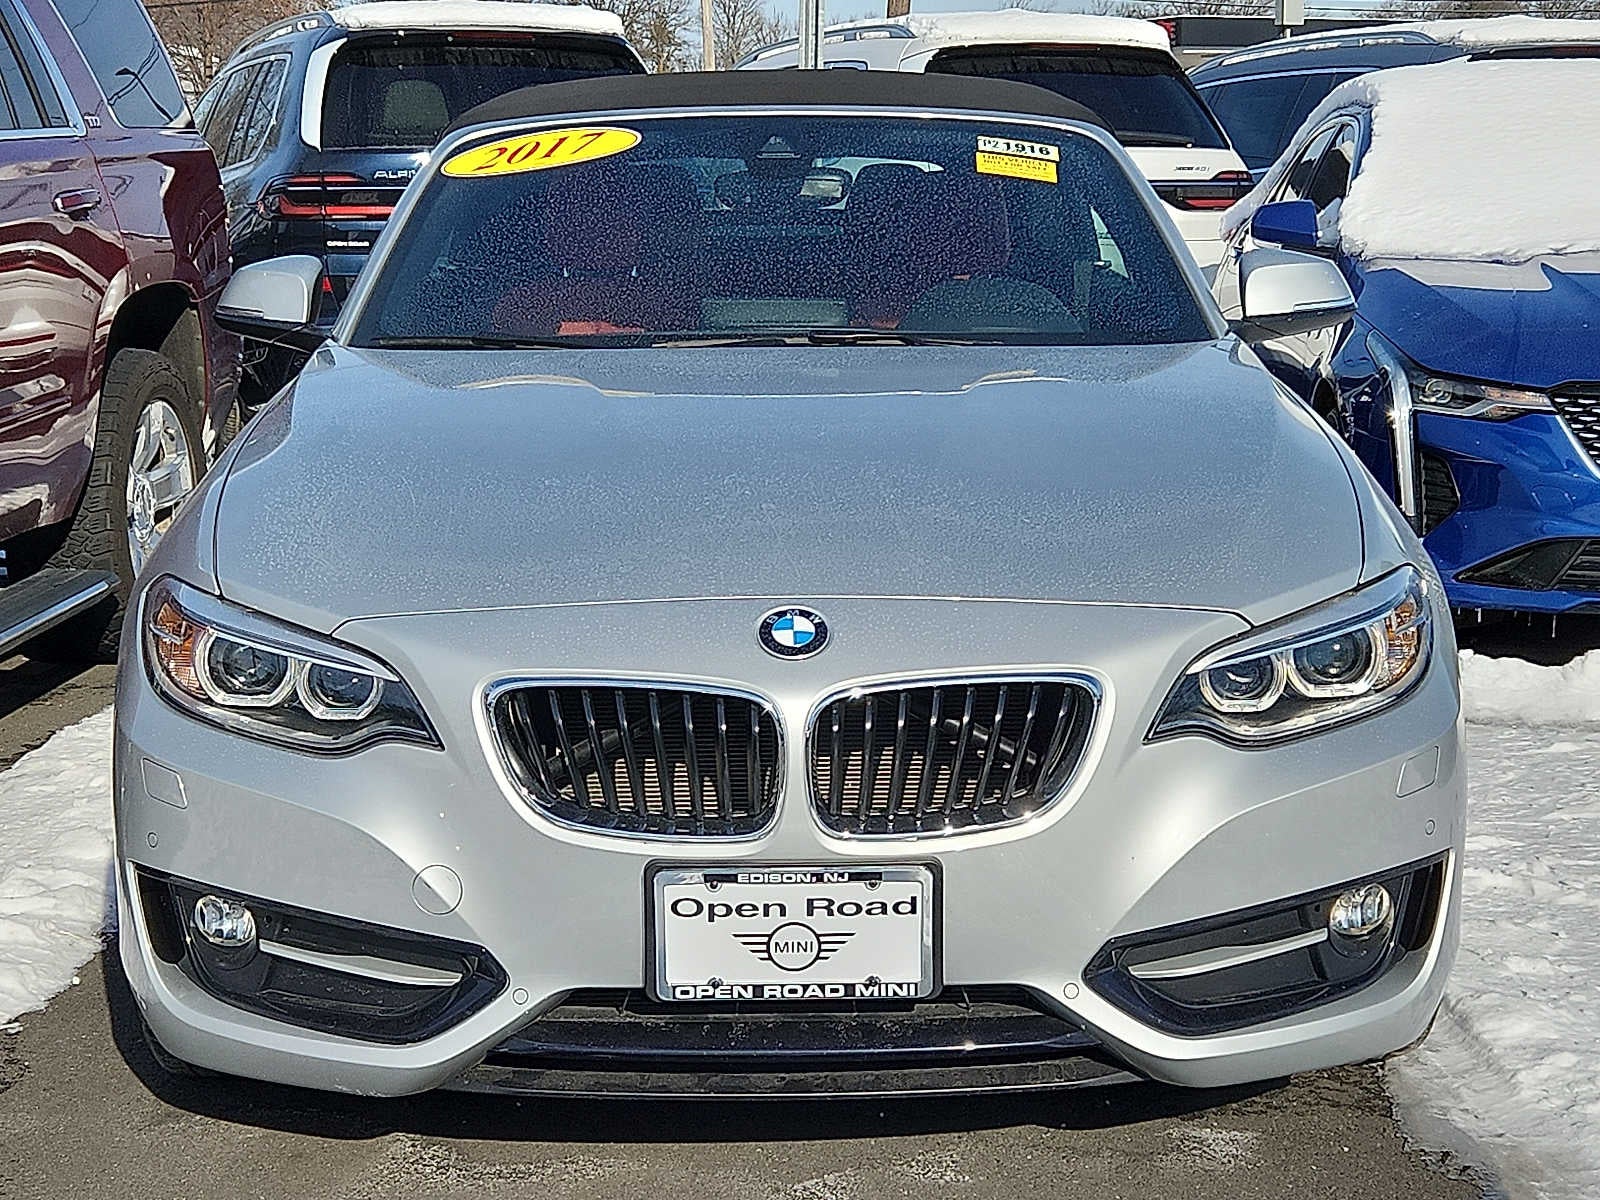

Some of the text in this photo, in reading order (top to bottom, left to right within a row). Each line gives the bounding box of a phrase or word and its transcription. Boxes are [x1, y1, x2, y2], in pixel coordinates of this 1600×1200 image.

[472, 131, 607, 171] 2017
[1003, 142, 1050, 156] 1916
[766, 610, 822, 624] BMW
[737, 872, 849, 884] EDISON, NJ
[670, 896, 917, 922] Open Road
[774, 940, 813, 953] MINI
[674, 983, 916, 999] OPEN ROAD MINI
